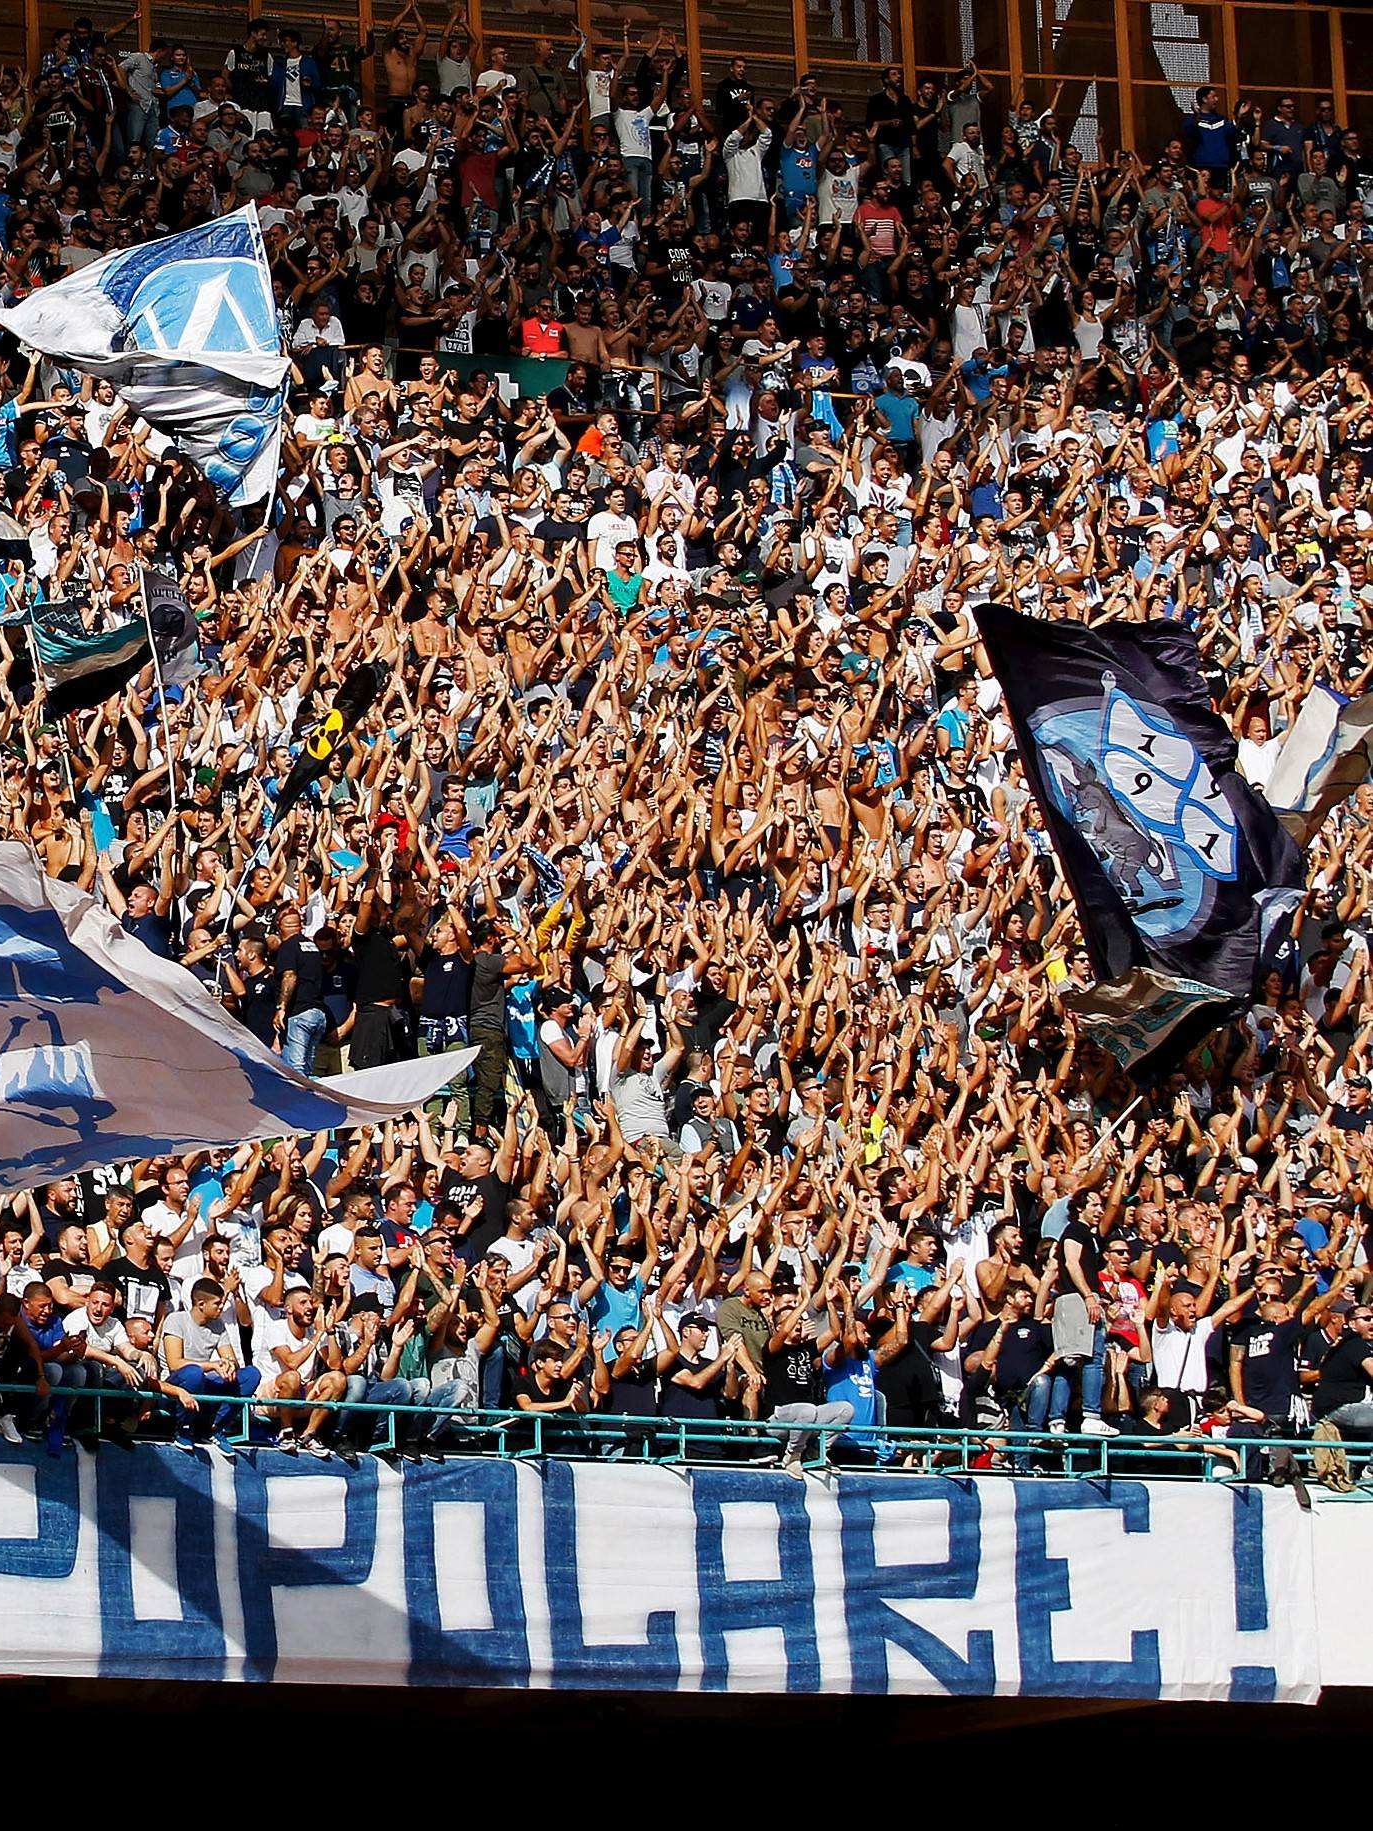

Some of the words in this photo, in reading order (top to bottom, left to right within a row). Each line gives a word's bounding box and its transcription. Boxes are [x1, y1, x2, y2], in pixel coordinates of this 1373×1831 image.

[1138, 733, 1157, 757] 1
[1130, 772, 1153, 796] 9
[1198, 833, 1220, 860] 1
